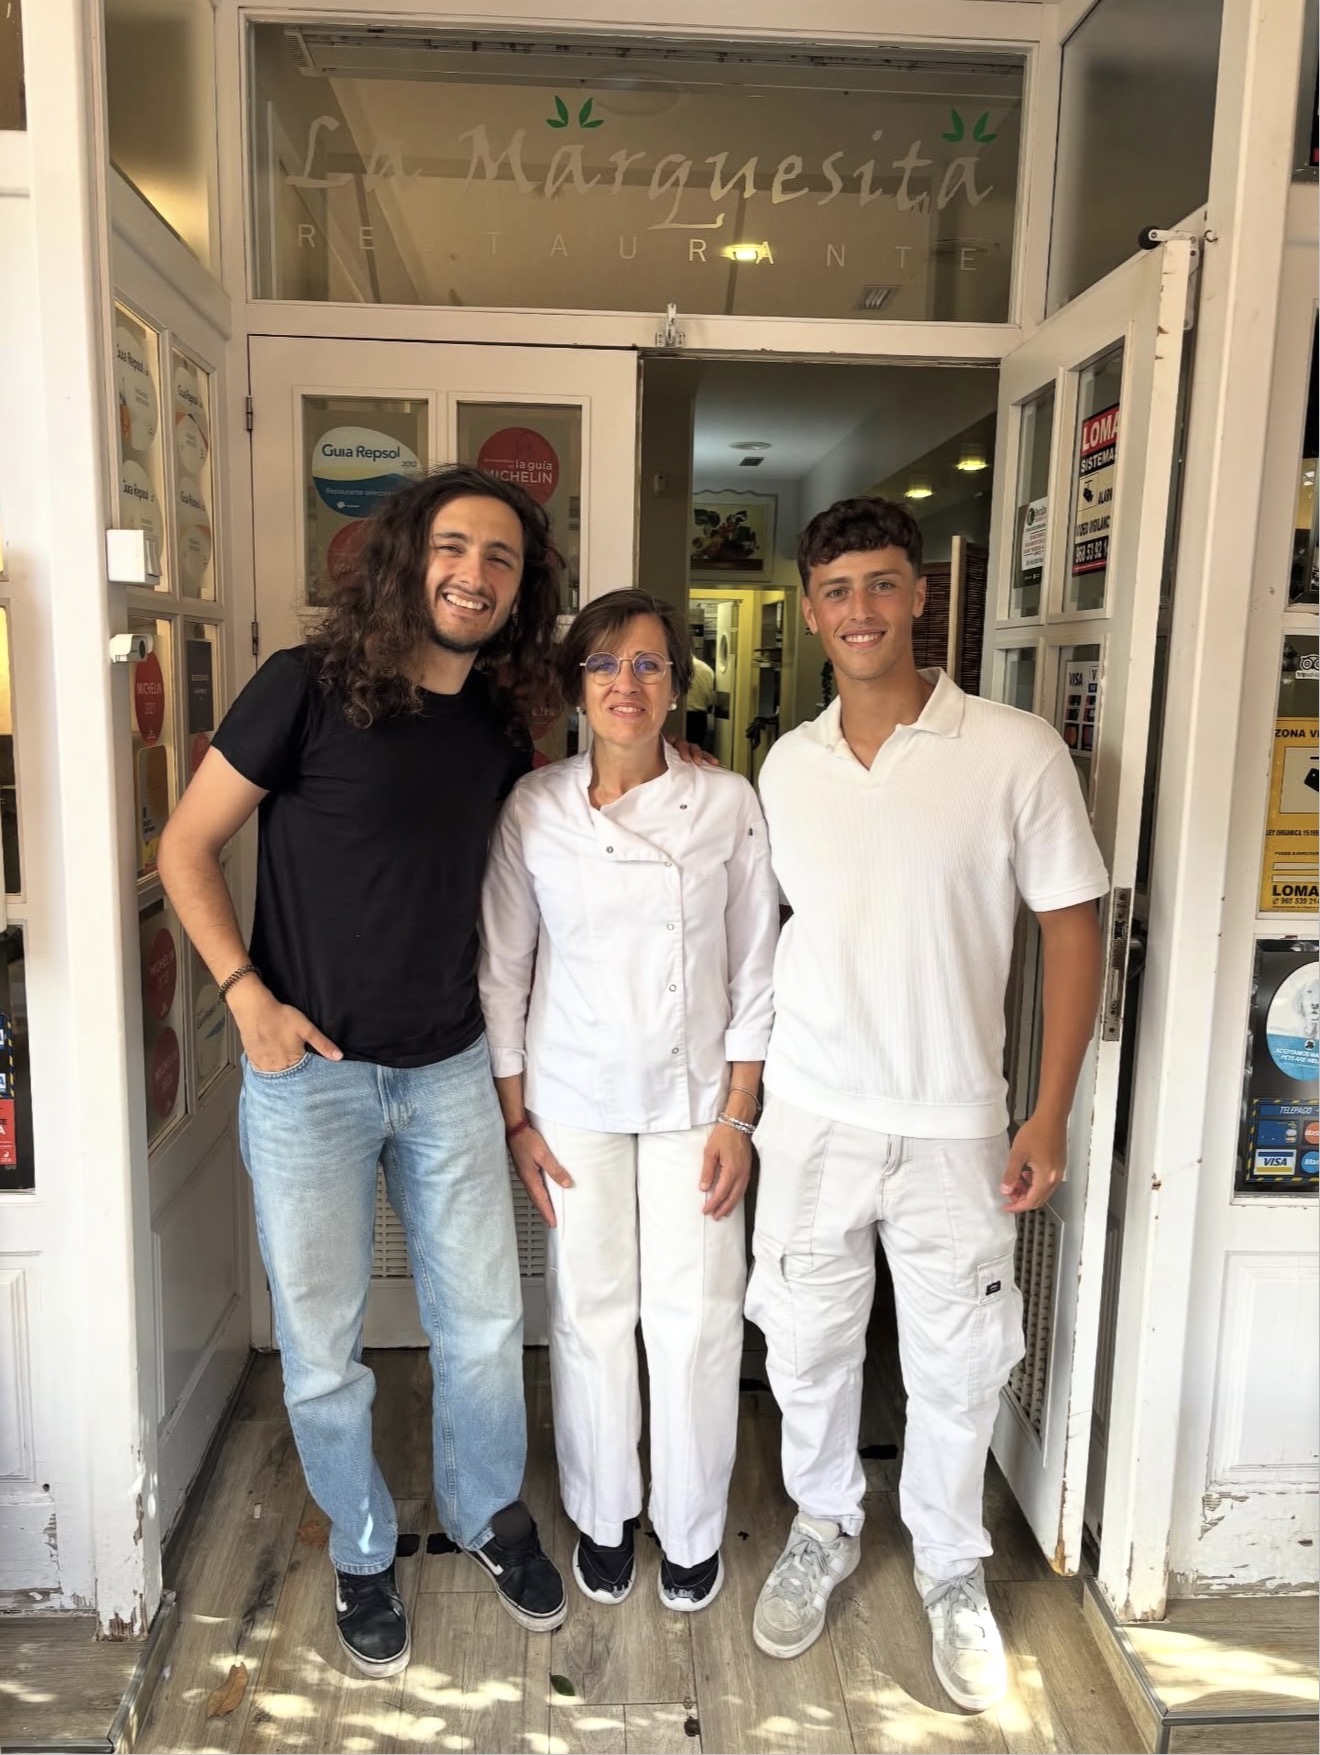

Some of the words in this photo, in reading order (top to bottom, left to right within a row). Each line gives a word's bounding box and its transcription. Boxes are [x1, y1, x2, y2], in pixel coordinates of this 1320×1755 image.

[286, 115, 422, 192] La
[459, 124, 993, 229] Marquesita
[299, 224, 977, 272] RETAURANTE
[355, 446, 401, 462] Repsol
[515, 460, 526, 469] la
[483, 469, 553, 483] MICHELIN
[1069, 672, 1083, 687] VISA
[136, 682, 162, 695] MICHELIN
[1275, 729, 1305, 738] ZONA
[1272, 885, 1319, 897] LOMA
[1280, 1107, 1313, 1115] TELEPAGO
[1263, 1158, 1288, 1167] VISA
